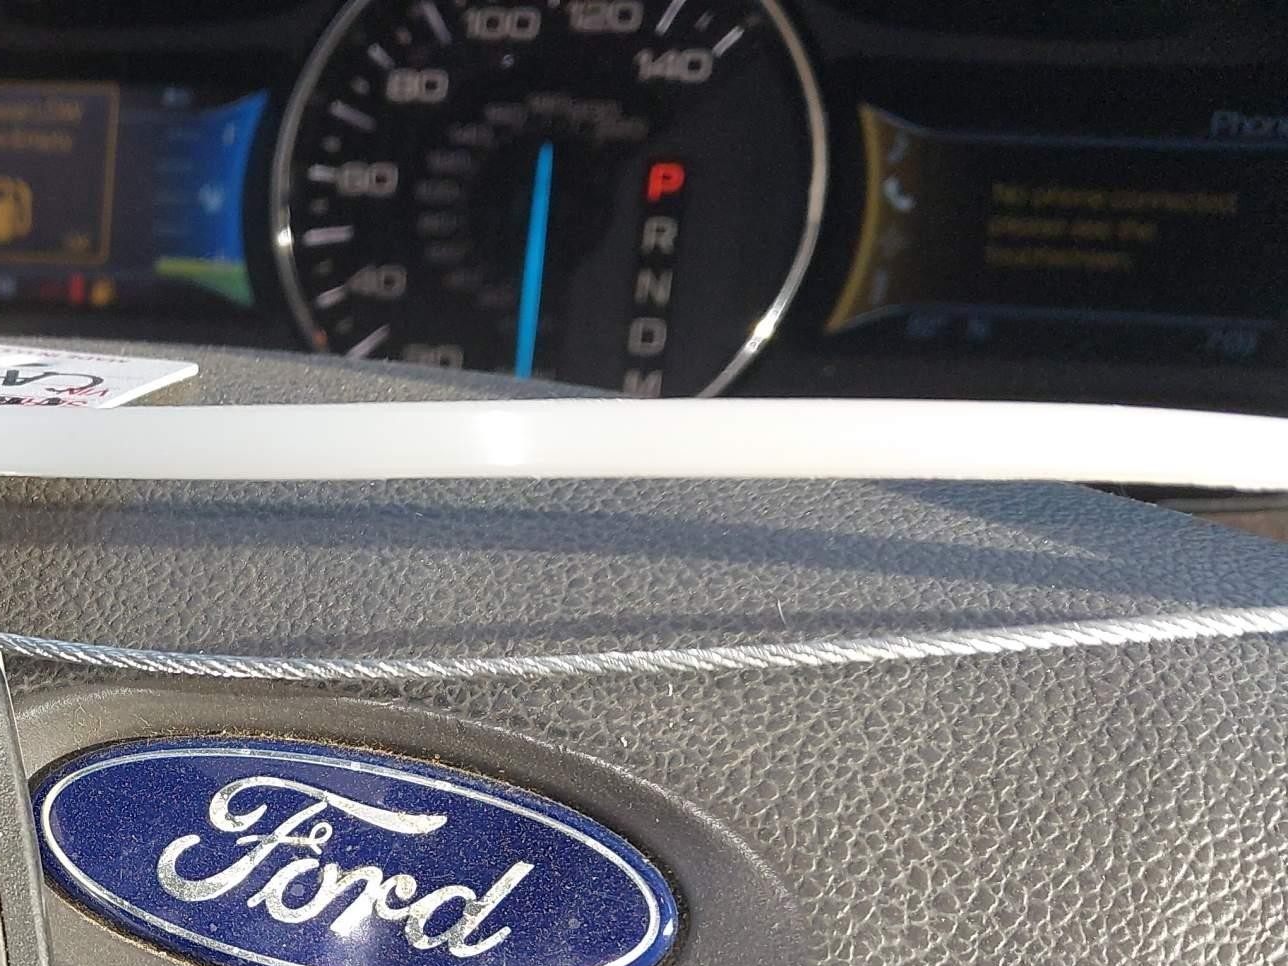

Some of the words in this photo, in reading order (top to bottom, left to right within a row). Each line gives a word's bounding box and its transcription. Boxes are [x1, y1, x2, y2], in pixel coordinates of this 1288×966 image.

[466, 8, 541, 39] 100
[568, 0, 643, 32] 120
[634, 48, 712, 83] 140
[386, 68, 449, 102] 80
[648, 162, 685, 201] P
[641, 216, 679, 255] R
[635, 270, 672, 309] N
[628, 317, 667, 355] D
[158, 776, 535, 957] Ford
